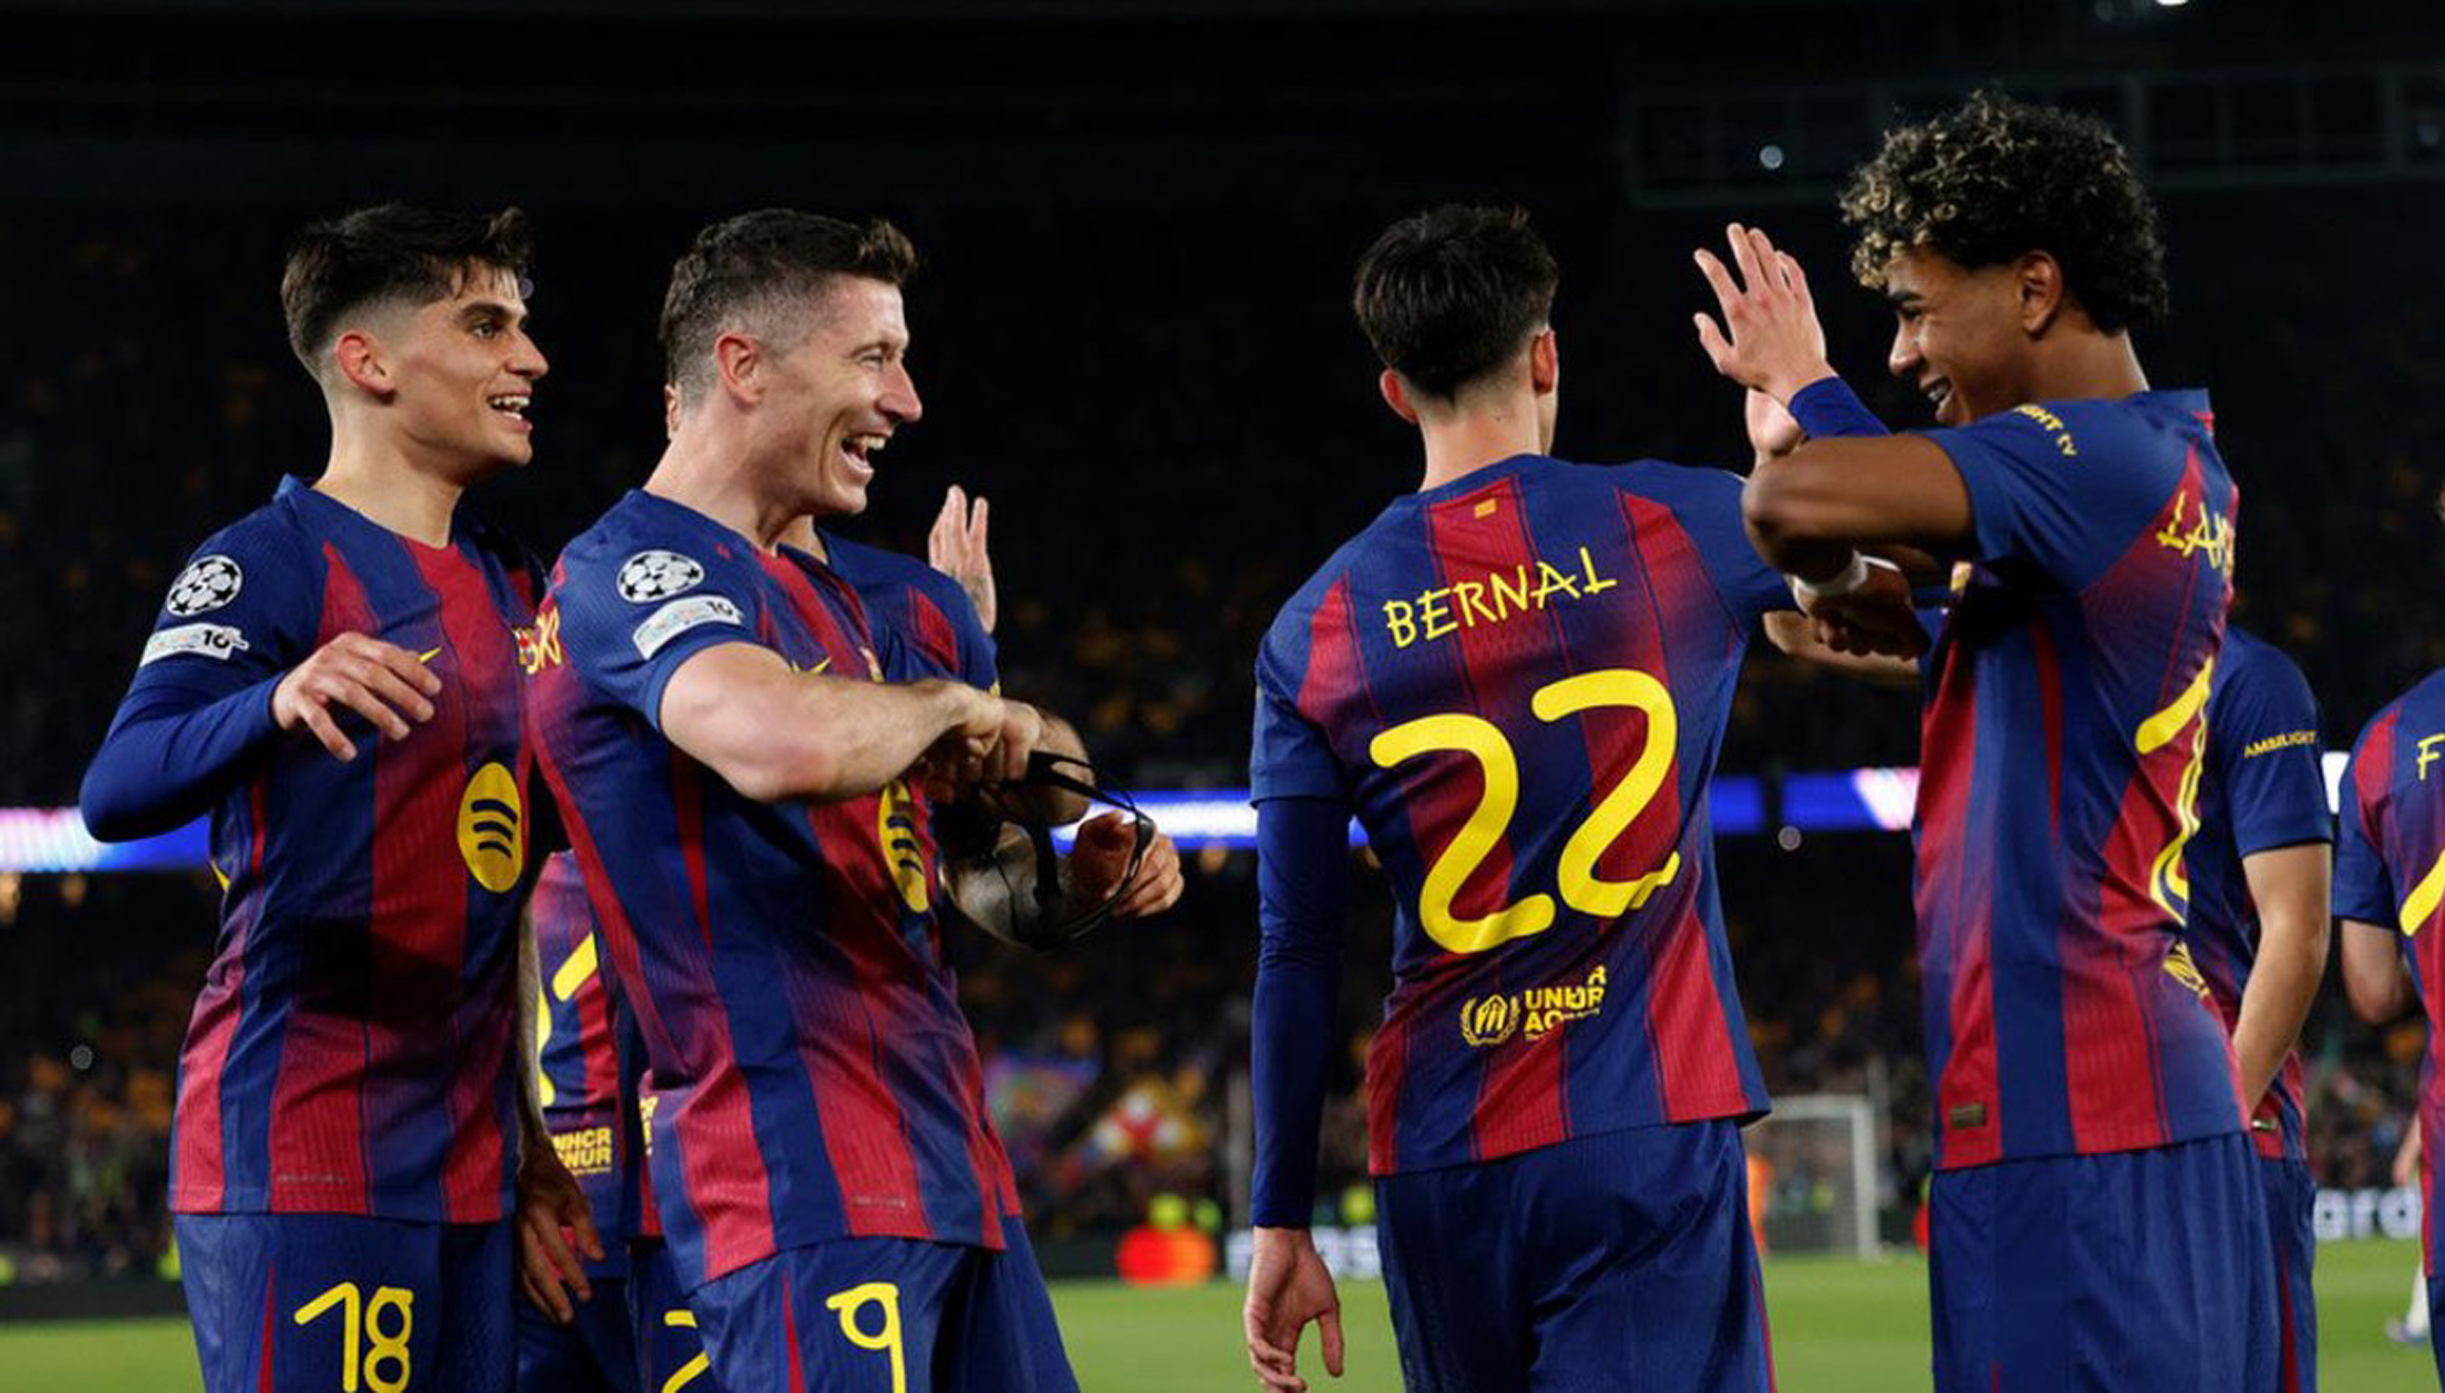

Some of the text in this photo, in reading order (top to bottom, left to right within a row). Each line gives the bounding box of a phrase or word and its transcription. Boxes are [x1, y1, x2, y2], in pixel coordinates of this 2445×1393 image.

[1383, 547, 1617, 648] BERNAL
[1369, 668, 1680, 954] 22
[294, 1281, 414, 1393] 18
[825, 1282, 907, 1393] 9
